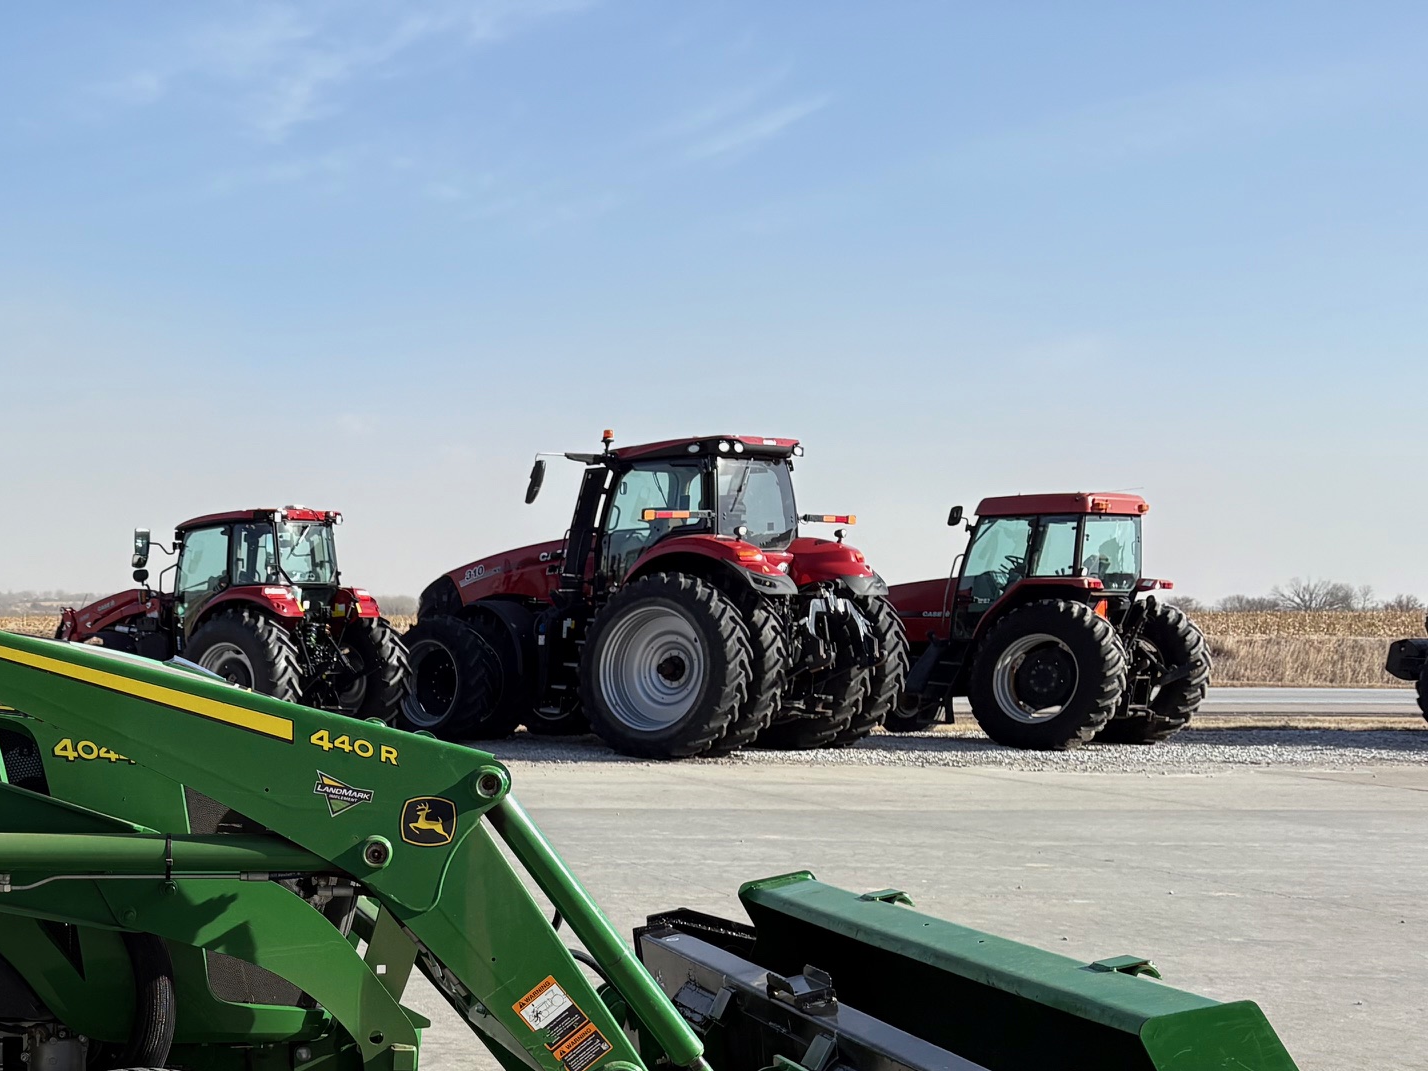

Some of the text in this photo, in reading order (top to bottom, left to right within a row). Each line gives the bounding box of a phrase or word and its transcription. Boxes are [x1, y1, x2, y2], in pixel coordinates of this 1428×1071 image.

[464, 564, 485, 581] 310
[52, 737, 136, 764] 404
[310, 729, 400, 767] 440 R
[328, 793, 358, 803] IMPLEMENT
[524, 980, 551, 1004] WARNING
[565, 1027, 592, 1050] WARNING
